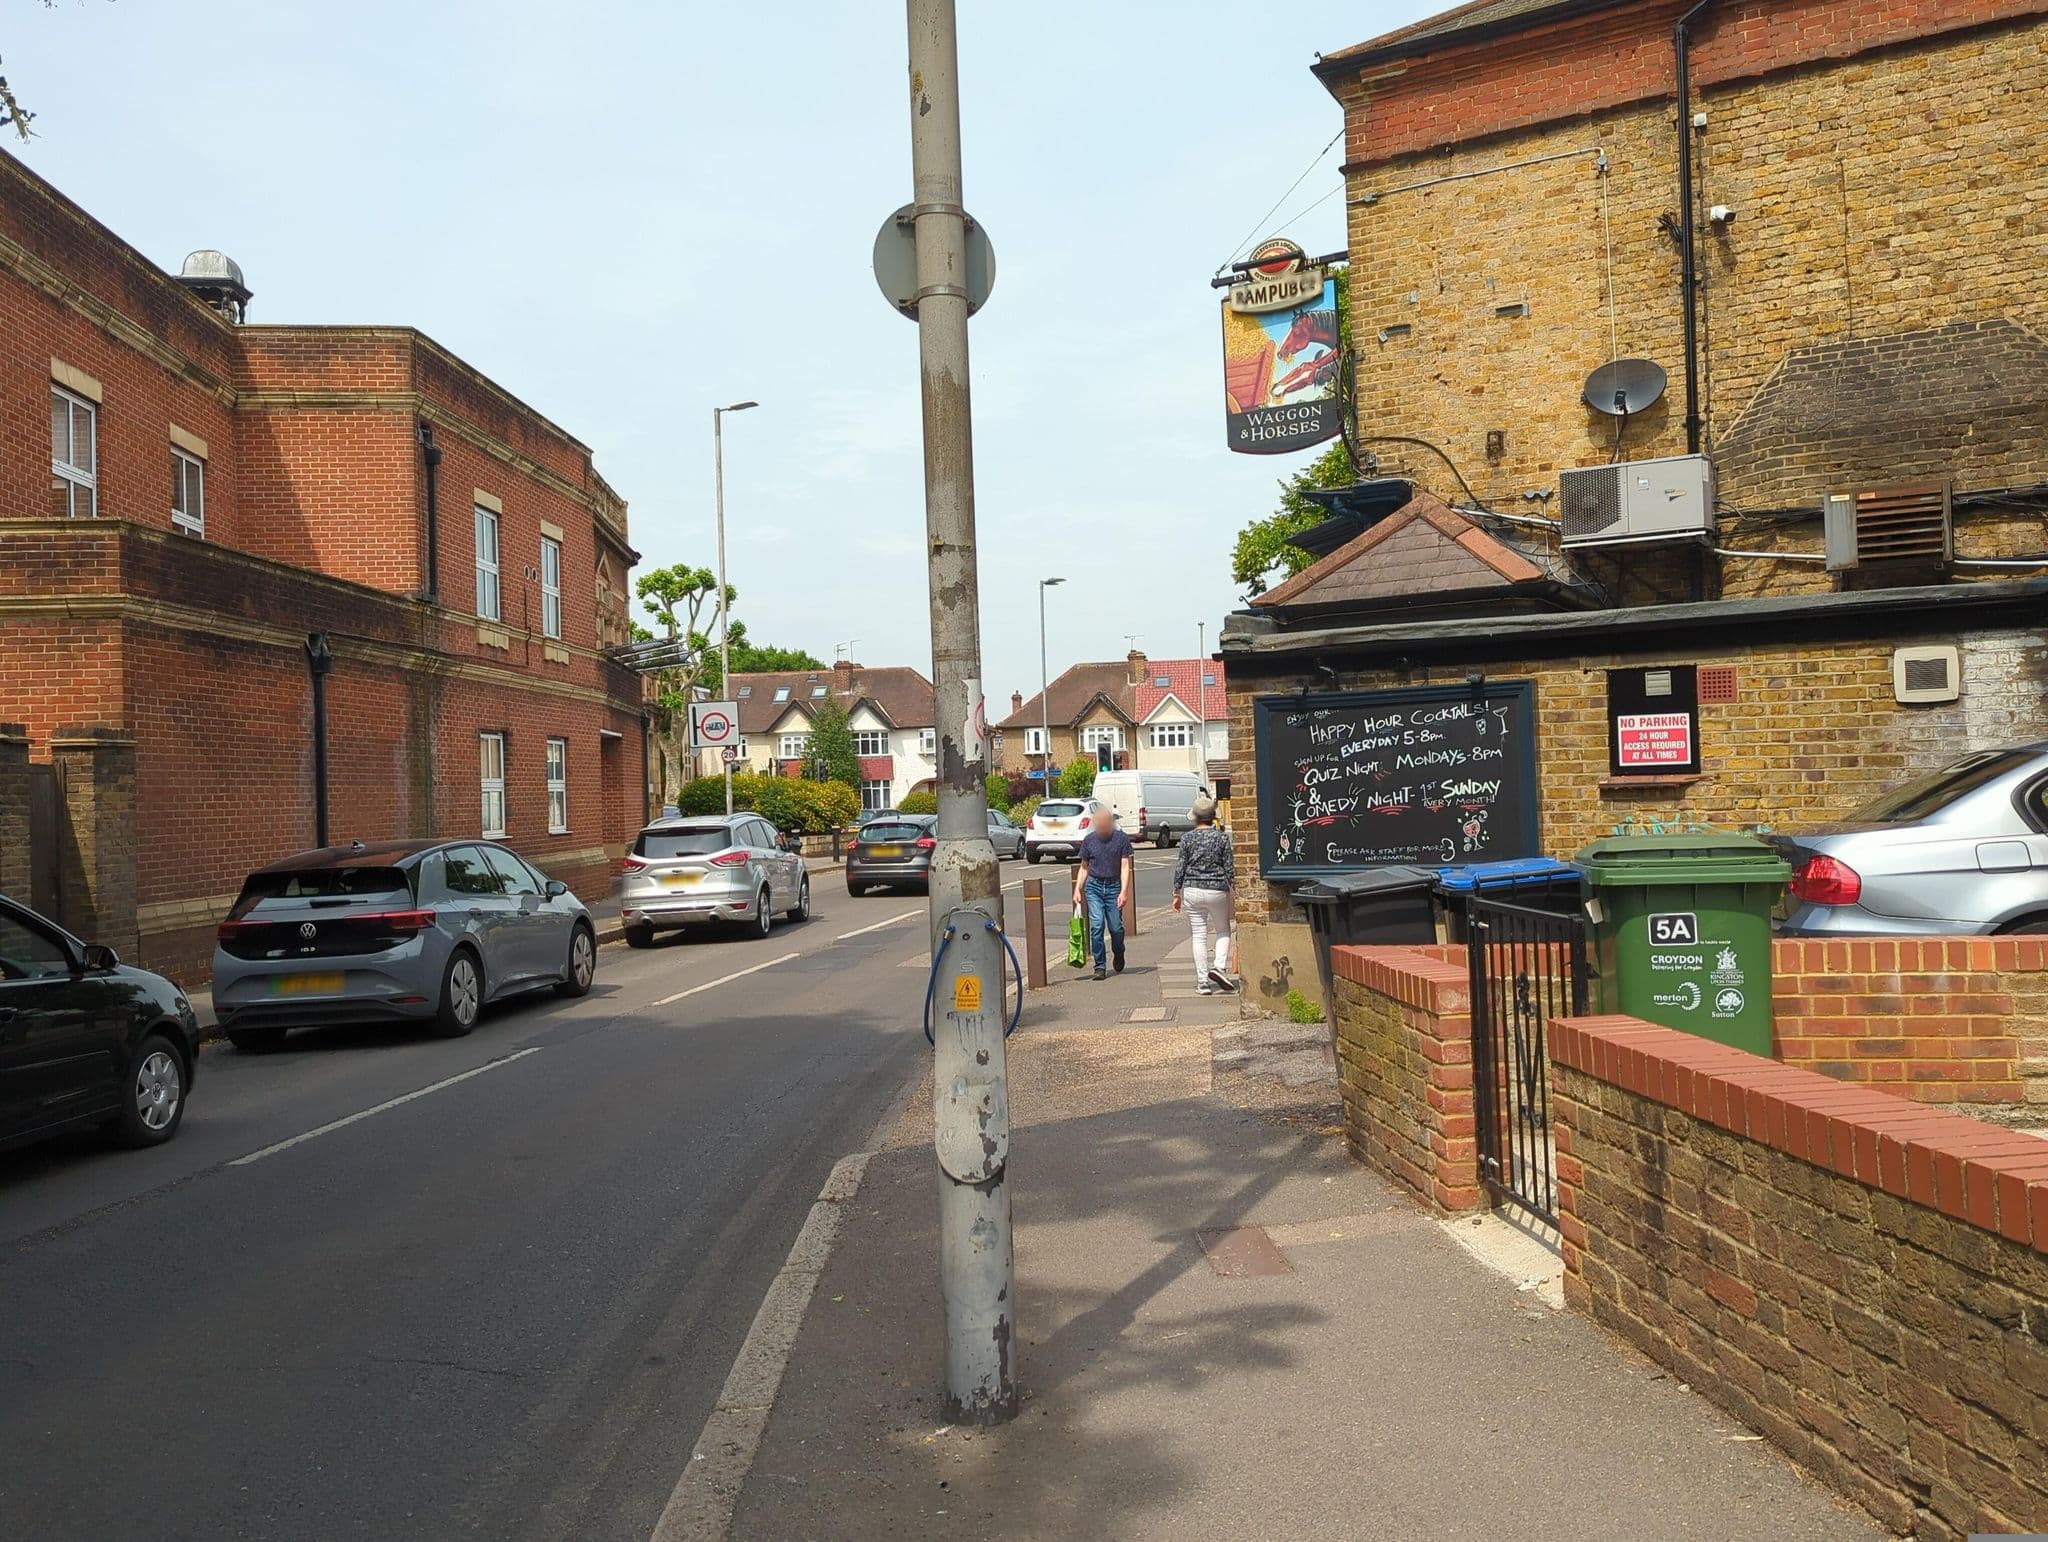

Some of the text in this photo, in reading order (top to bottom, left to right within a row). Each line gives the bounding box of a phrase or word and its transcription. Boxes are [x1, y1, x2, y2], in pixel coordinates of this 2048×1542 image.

[1246, 404, 1322, 427] WAGGON
[1240, 420, 1320, 442] & HORSES
[1310, 700, 1489, 745] HAPPY HOUR COCKTAILS!
[1620, 715, 1687, 728] NO PARKING
[1639, 731, 1669, 740] 24 HOUR
[1340, 734, 1400, 758] EVERYDAY
[1623, 740, 1686, 750] ACCESS REQUIRED
[1294, 755, 1313, 769] SIGN
[1314, 754, 1325, 763] UP
[1632, 750, 1678, 760] AT ALL TIMES
[1303, 766, 1342, 786] QUIZ
[1294, 796, 1359, 823] COMEDY
[1440, 779, 1501, 799] SUNDAY
[1309, 787, 1322, 805] &
[1360, 847, 1375, 855] ASK
[1364, 854, 1418, 862] INFORMATION
[1656, 919, 1691, 940] 5A
[1651, 955, 1703, 964] CROYDON
[1653, 994, 1688, 1002] merton
